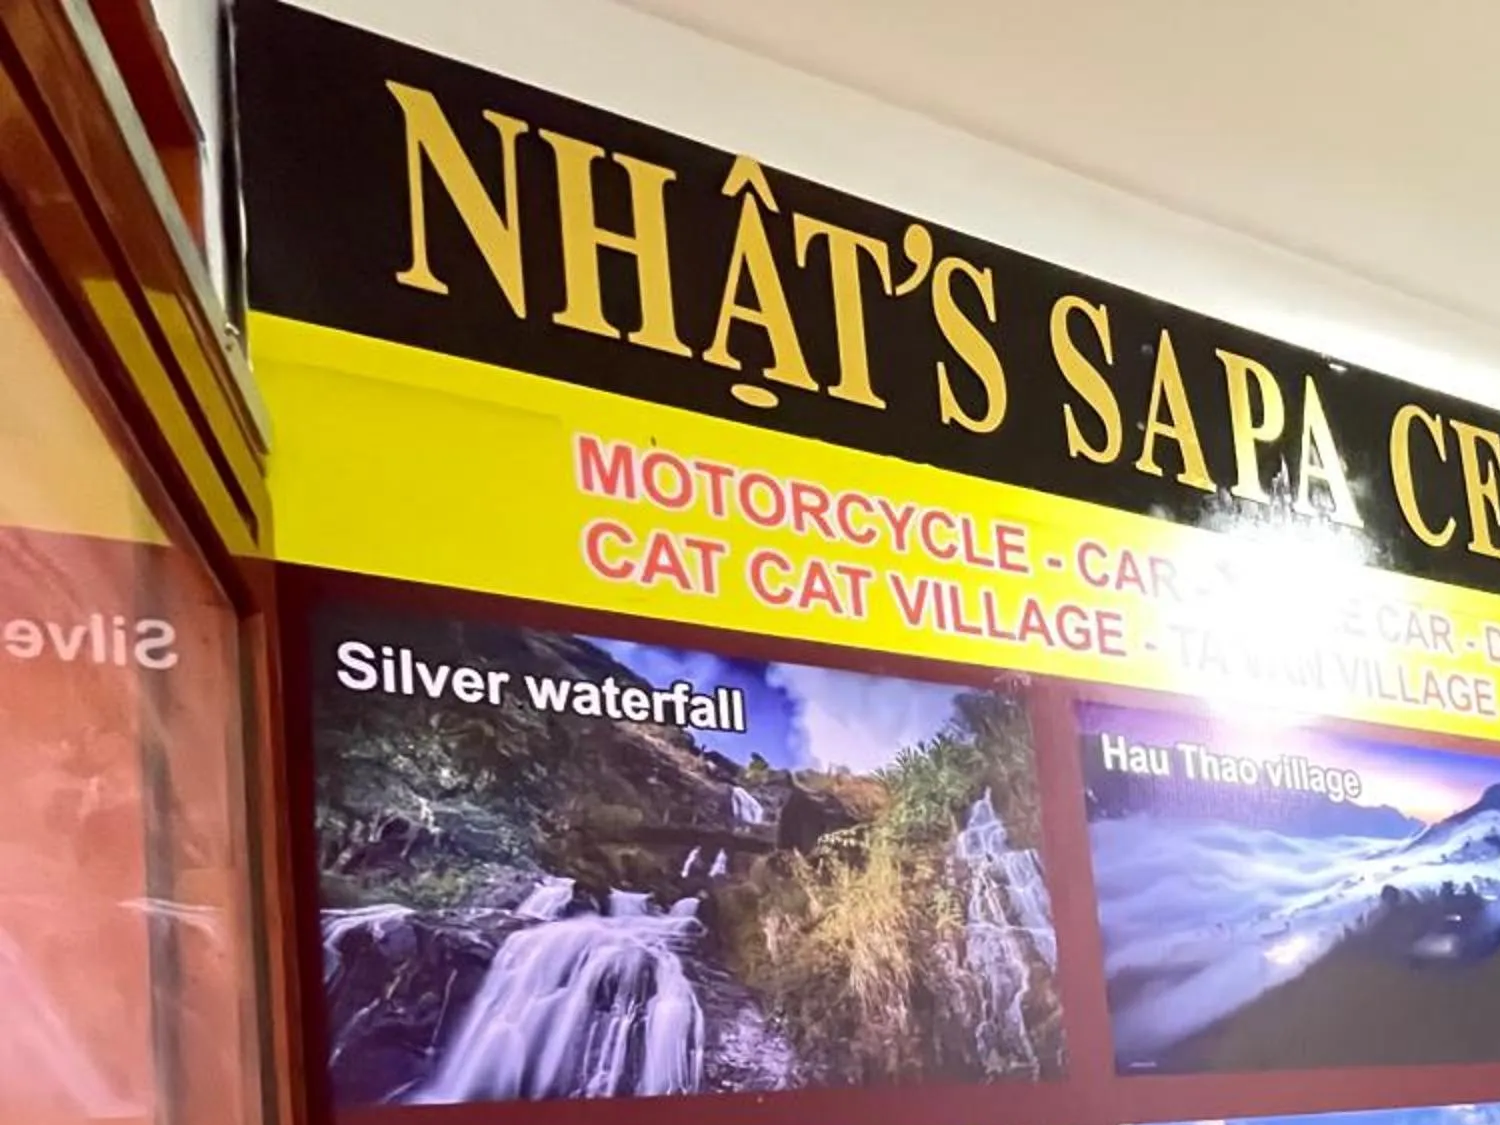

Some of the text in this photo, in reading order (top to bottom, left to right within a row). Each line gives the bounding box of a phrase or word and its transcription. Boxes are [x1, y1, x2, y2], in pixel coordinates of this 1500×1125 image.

[1050, 295, 1364, 528] SAPA
[578, 436, 1029, 573] MOTORCYCLE
[1077, 541, 1182, 601] CAR
[586, 521, 726, 595] CAT
[750, 550, 872, 618] CAT
[889, 572, 1129, 658] VILLAGE
[1335, 650, 1497, 717] VILLAGE
[1375, 603, 1455, 654] CAR
[336, 640, 747, 735] Silver waterfall
[1101, 731, 1363, 803] Hau Thao village
